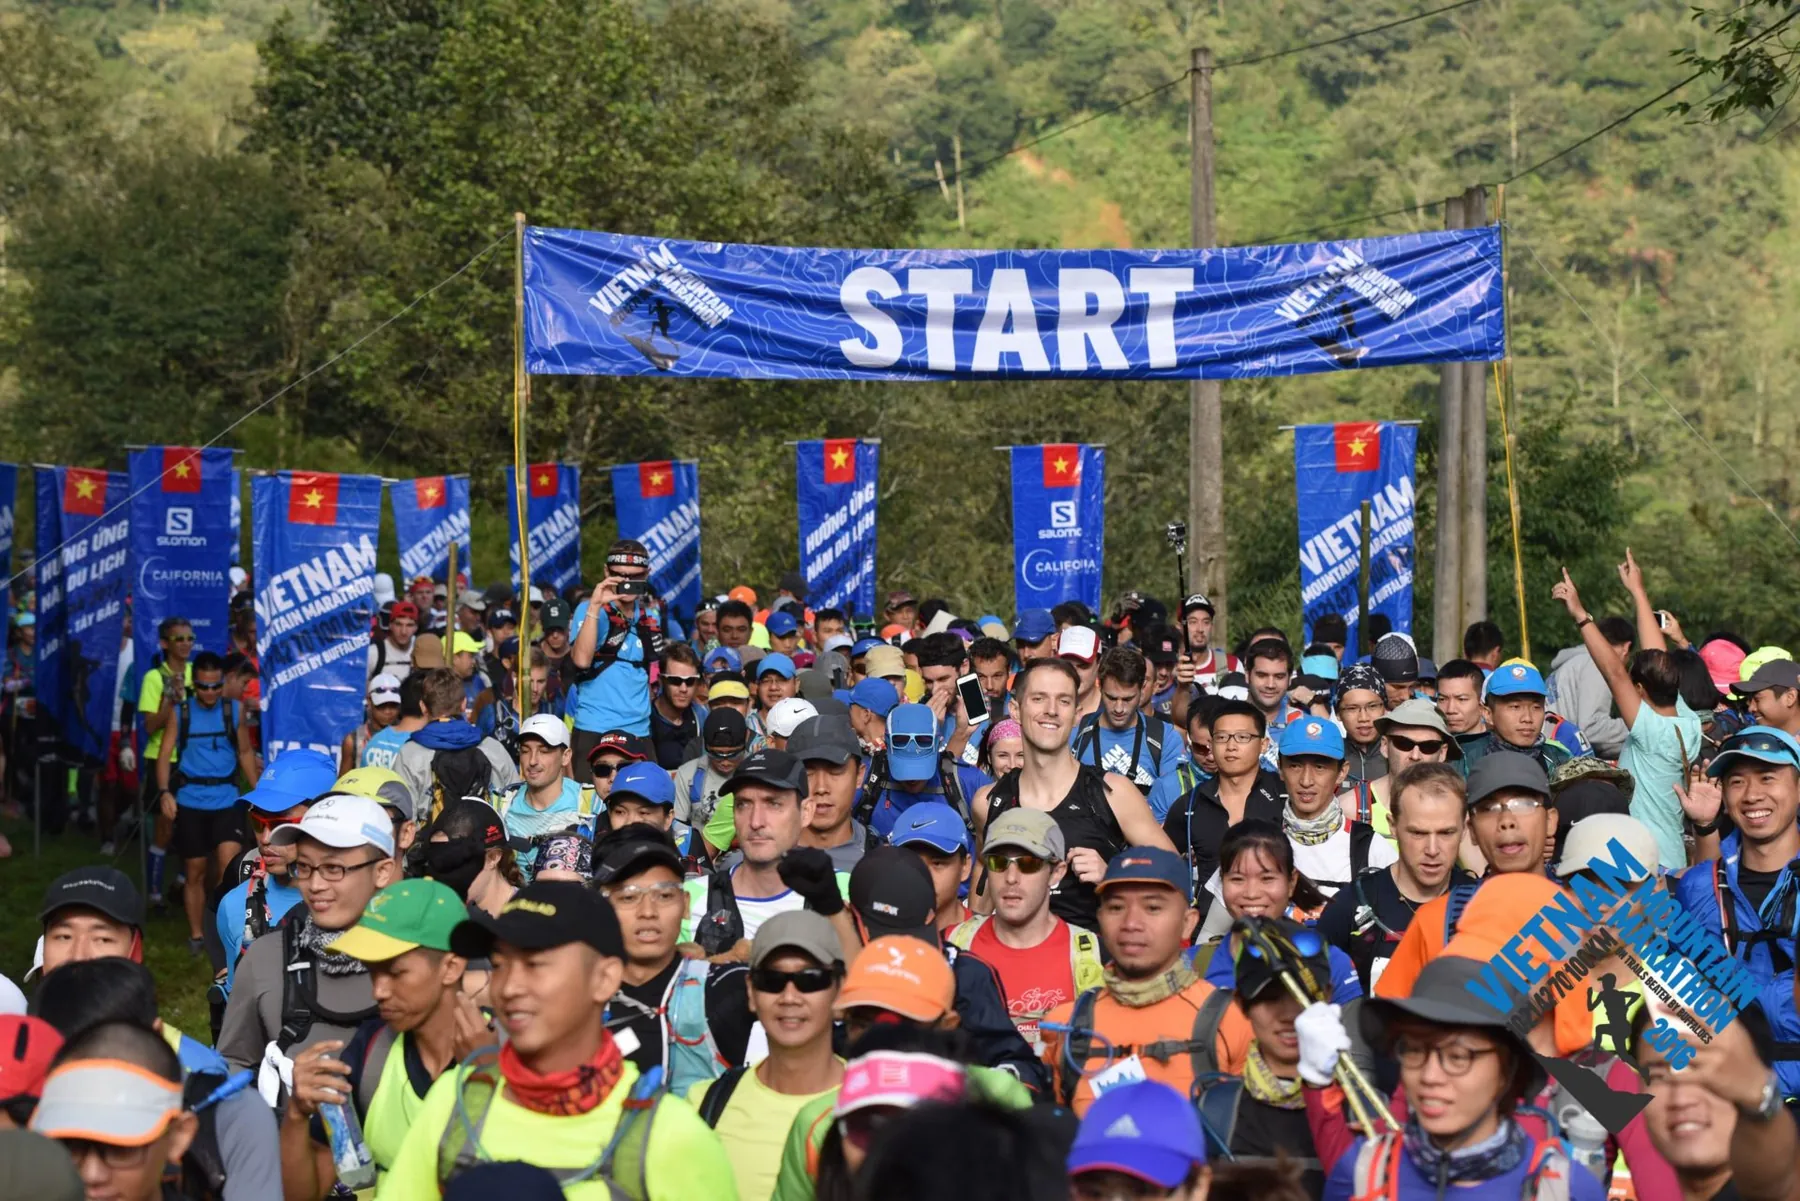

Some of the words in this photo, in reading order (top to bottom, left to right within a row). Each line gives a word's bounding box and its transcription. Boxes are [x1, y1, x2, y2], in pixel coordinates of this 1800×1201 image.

[588, 243, 678, 316] VIETNAM
[656, 271, 723, 329] MARATHON
[669, 263, 734, 320] MOUNTAIN
[838, 266, 1195, 373] START
[400, 507, 471, 576] VIETNAM
[1300, 475, 1415, 576] VIETNAM
[1301, 553, 1360, 605] MOUNTAIN
[1357, 515, 1414, 559] ARATHON
[254, 534, 376, 626] VIETNAM
[301, 575, 374, 621] MARATHON
